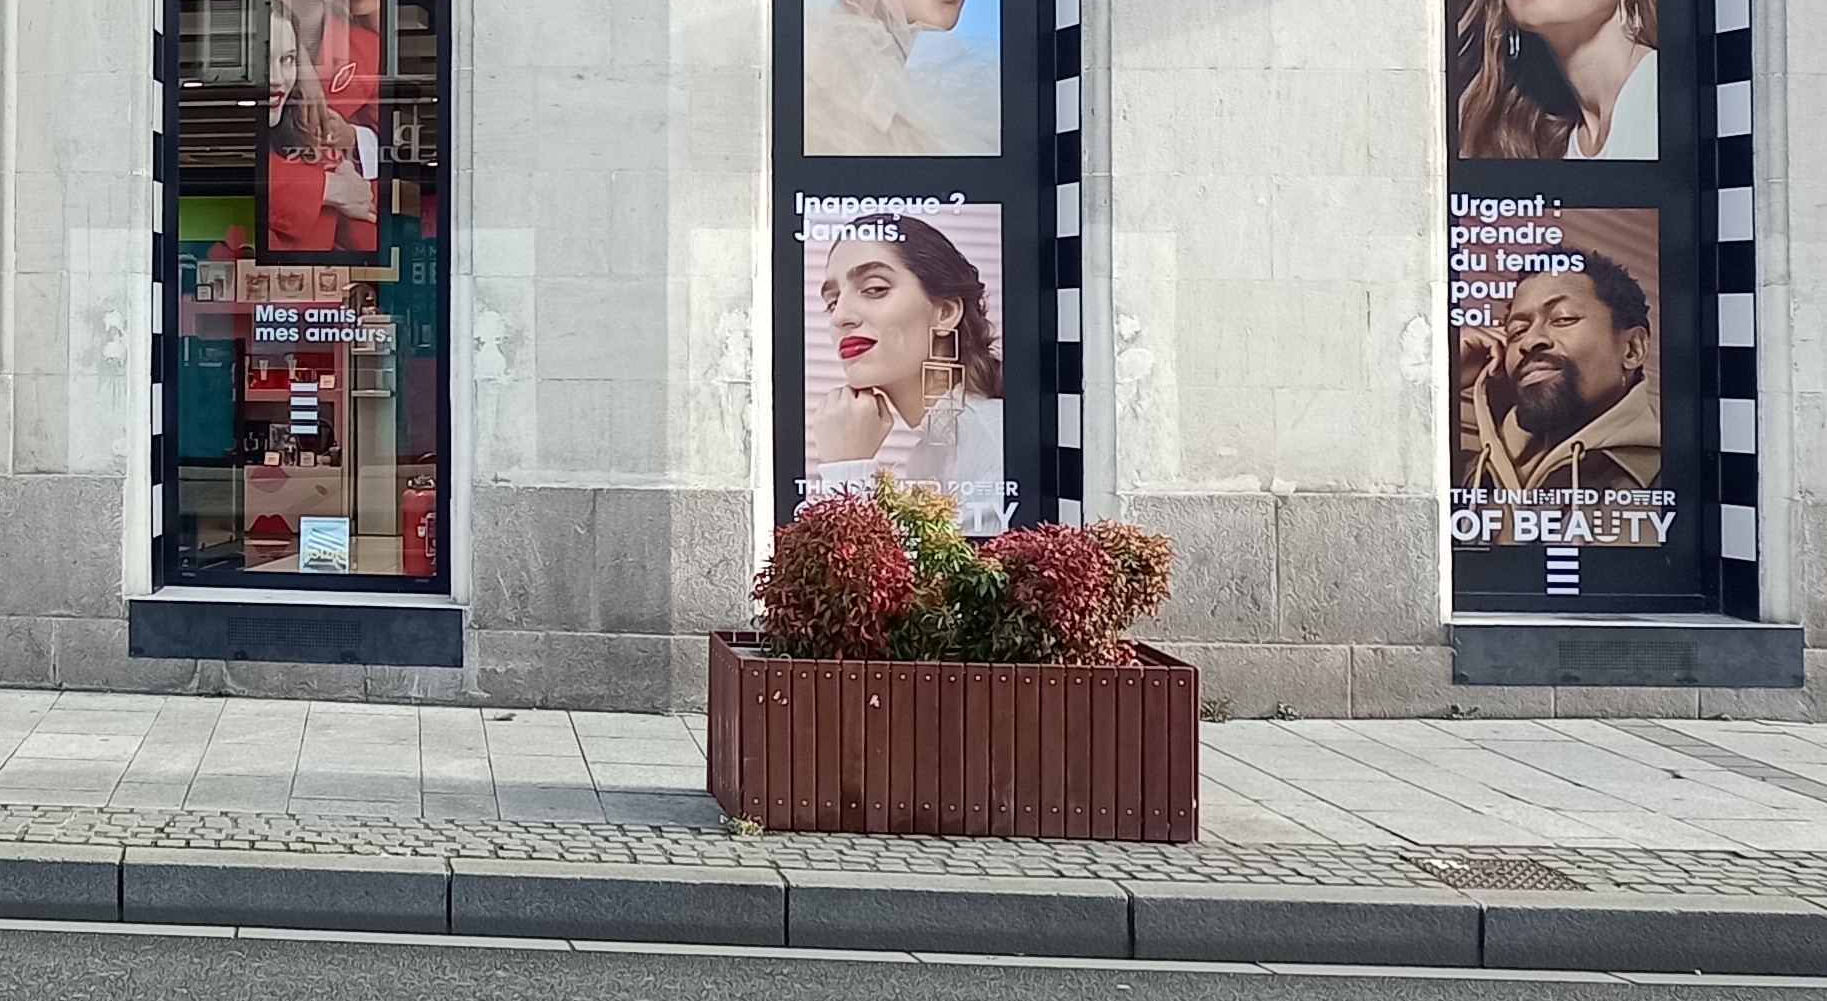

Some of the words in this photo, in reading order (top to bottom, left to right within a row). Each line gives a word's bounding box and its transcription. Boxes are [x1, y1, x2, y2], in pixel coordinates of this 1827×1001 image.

[795, 192, 940, 220] Inaperçue
[949, 192, 966, 214] ?
[1450, 194, 1545, 223] Urgent
[794, 219, 906, 242] Jamais.
[1451, 222, 1563, 248] prendre
[1451, 249, 1487, 271] du
[1495, 249, 1585, 276] temps
[1451, 281, 1517, 303] pour
[256, 305, 298, 322] Mes
[304, 305, 362, 326] amis,
[1450, 304, 1499, 326] soi.
[255, 327, 299, 342] mes
[305, 327, 393, 342] amours.
[1450, 488, 1487, 504] THE
[1493, 489, 1598, 505] UNLIMITED
[1605, 489, 1676, 506] POWER
[1450, 509, 1503, 541] OF
[1514, 510, 1676, 543] BEAUTY
